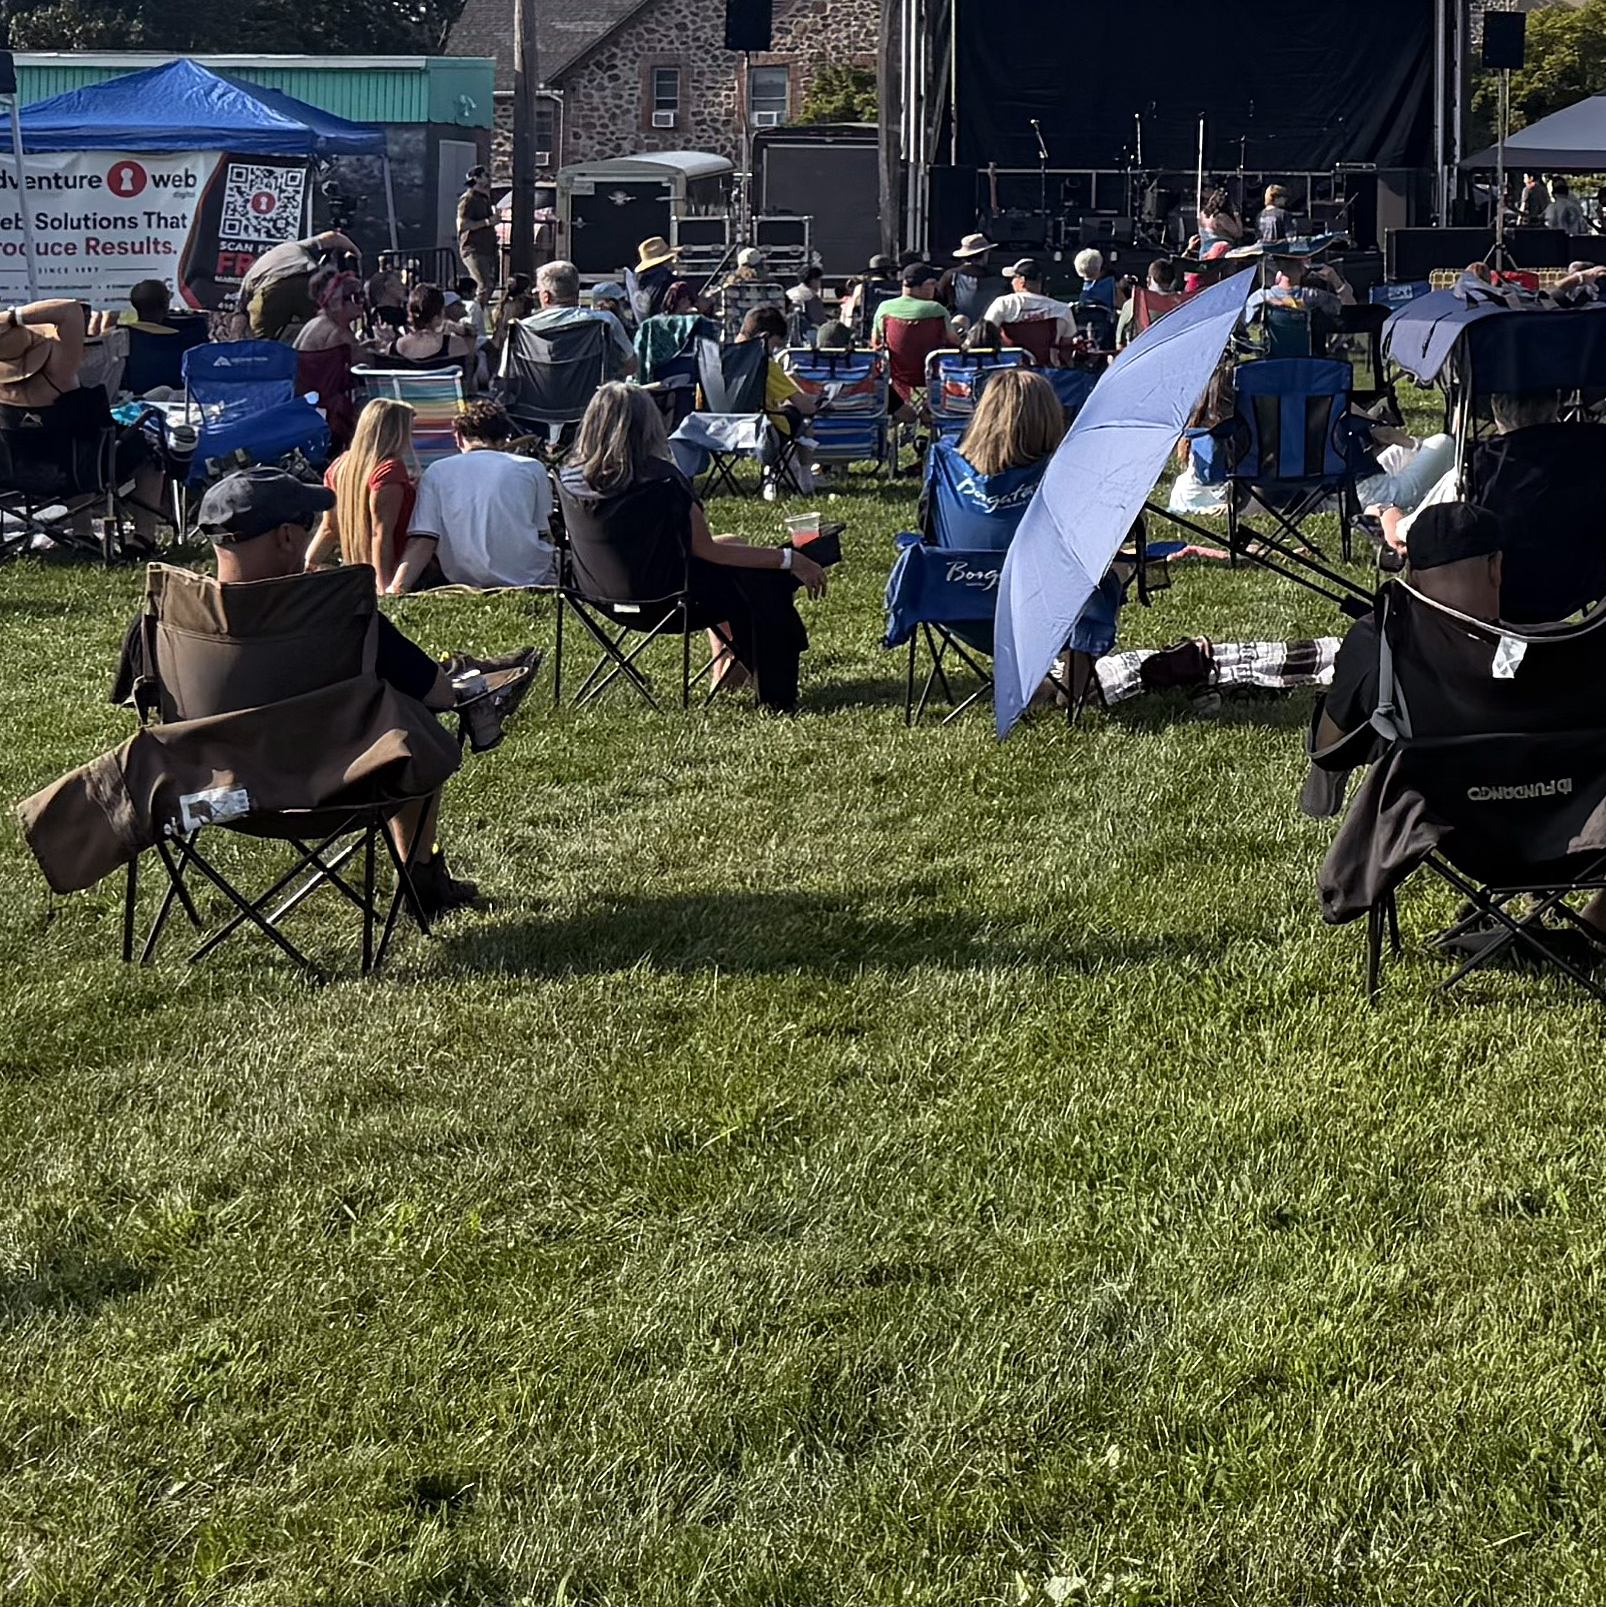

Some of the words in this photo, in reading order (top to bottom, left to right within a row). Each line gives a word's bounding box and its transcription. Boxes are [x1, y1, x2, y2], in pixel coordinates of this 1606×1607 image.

[151, 168, 197, 189] web
[0, 212, 24, 230] eb
[35, 212, 139, 230] Solutions
[143, 211, 188, 230] That
[85, 236, 178, 256] Results.
[219, 241, 253, 252] SCAN
